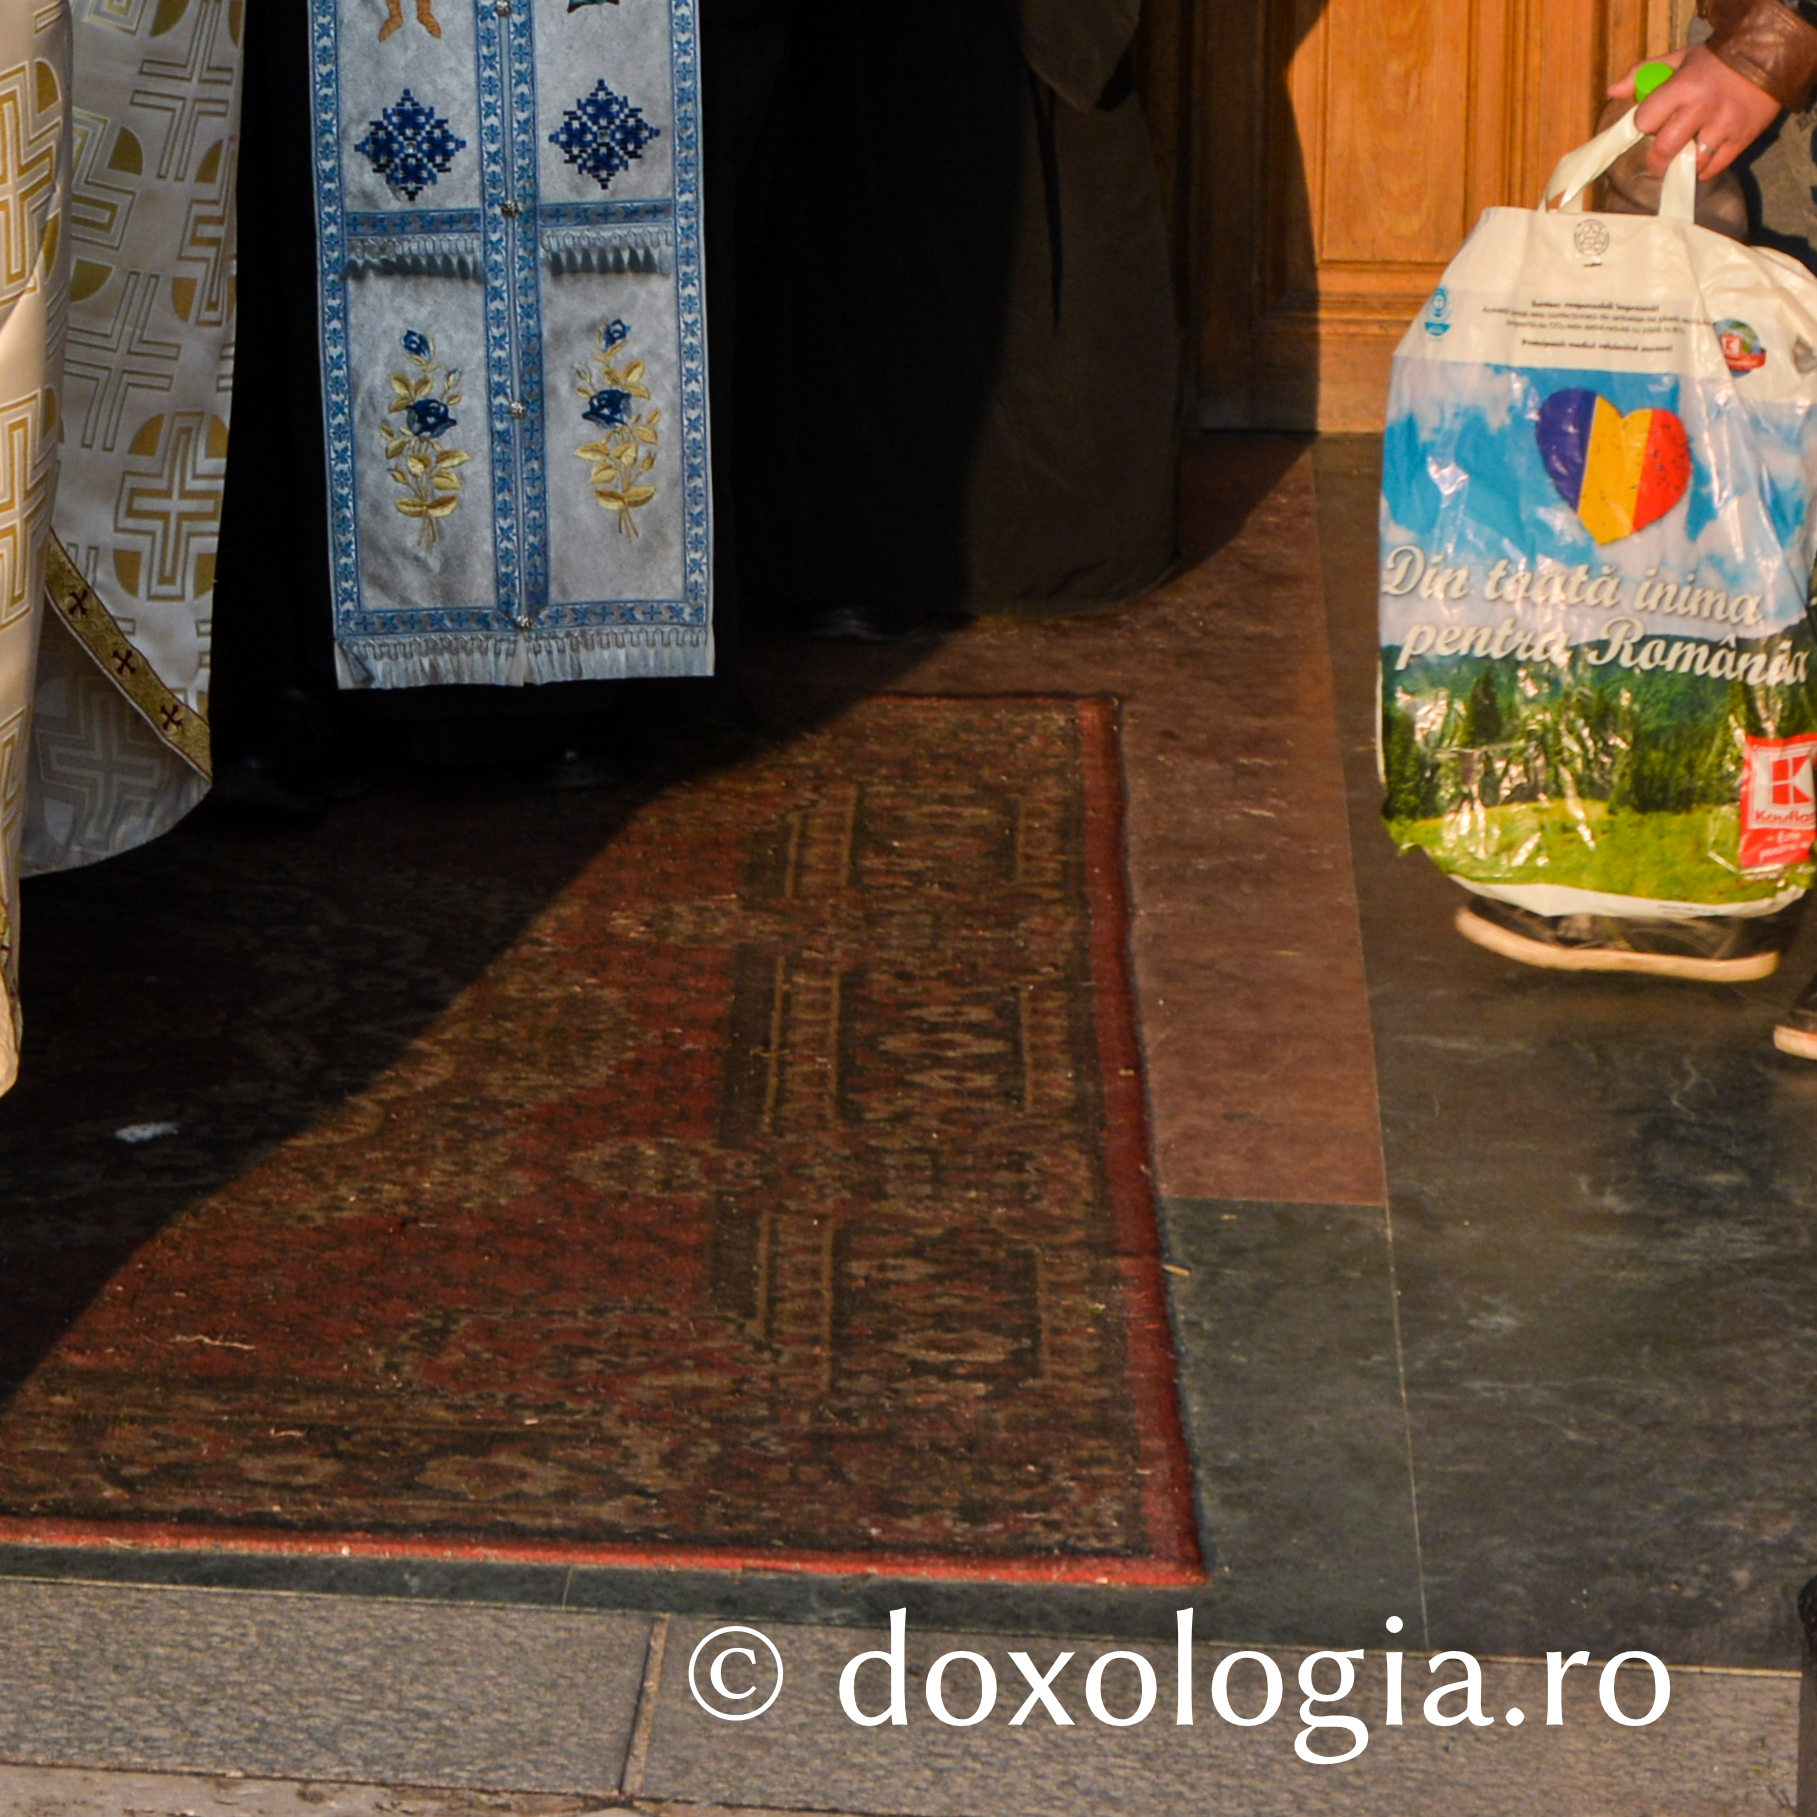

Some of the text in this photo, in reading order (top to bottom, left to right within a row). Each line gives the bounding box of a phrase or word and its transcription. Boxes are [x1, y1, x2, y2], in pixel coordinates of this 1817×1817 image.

[1382, 545, 1766, 627] Din toată inima
[1394, 616, 1810, 687] pentru România
